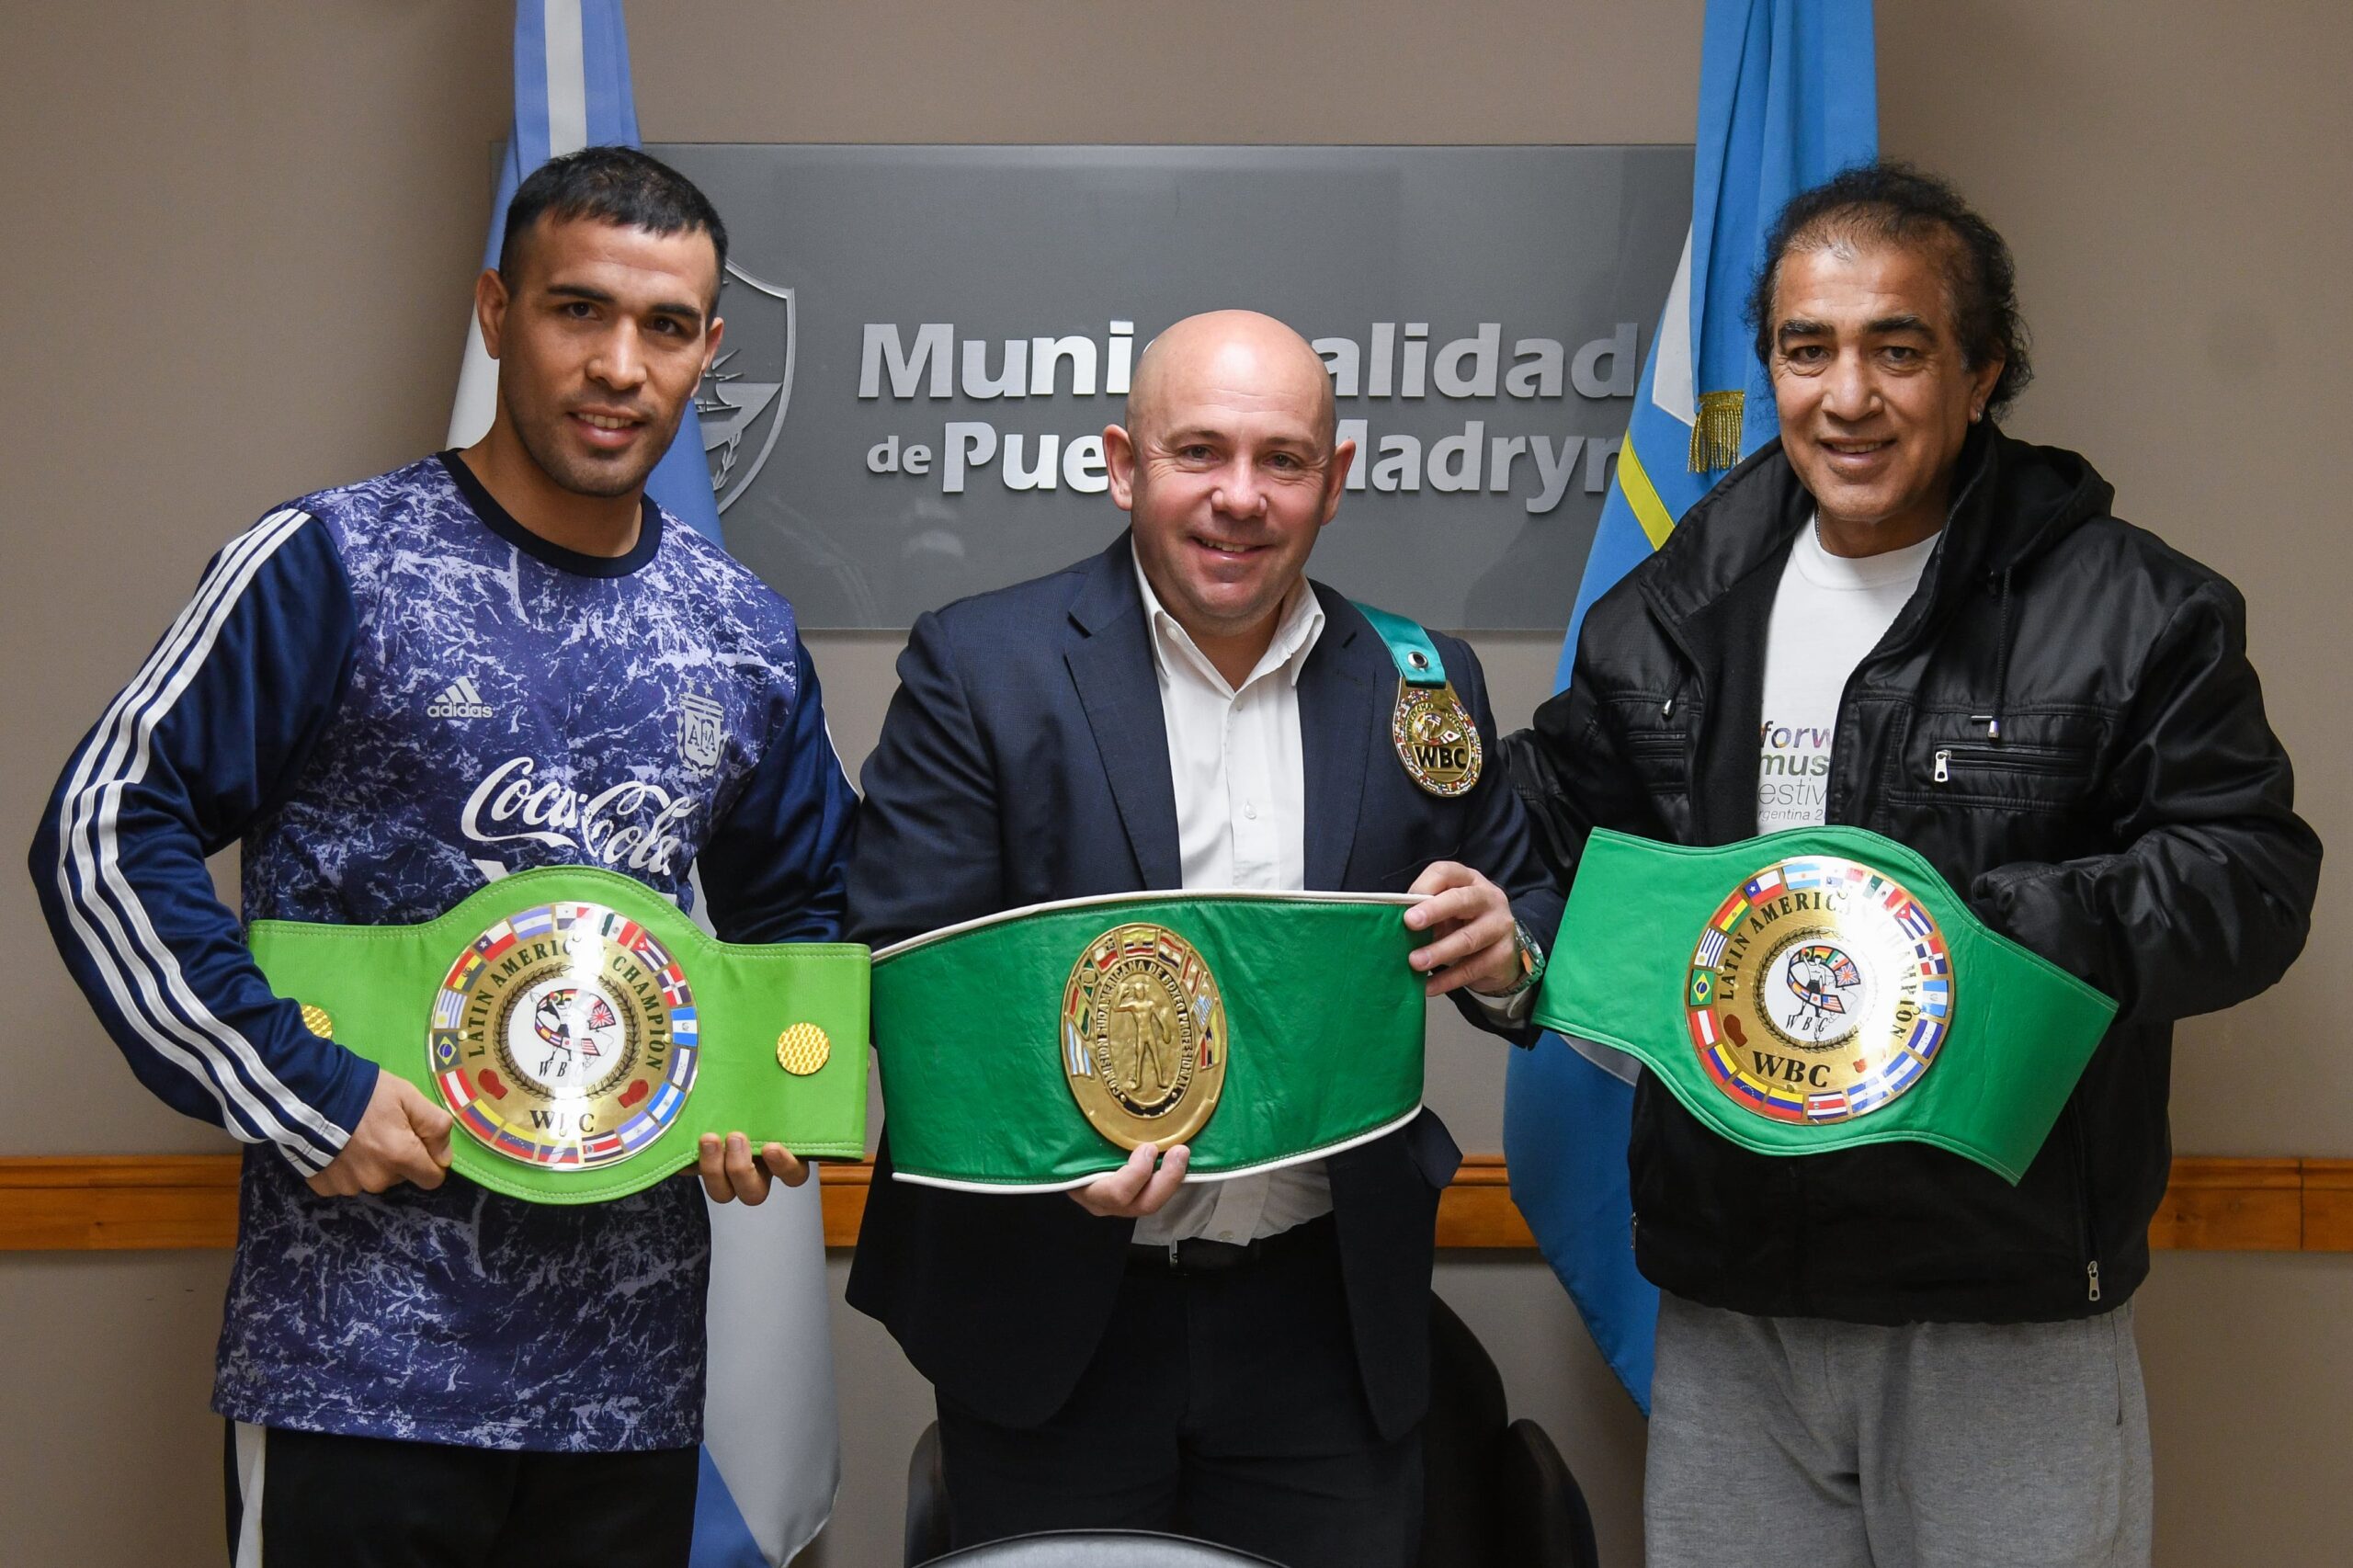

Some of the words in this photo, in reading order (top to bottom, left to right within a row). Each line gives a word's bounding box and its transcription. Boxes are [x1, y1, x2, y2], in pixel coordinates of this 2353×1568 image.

[858, 320, 1638, 399] Munialidad
[866, 436, 932, 474] de
[942, 421, 1109, 493] Pue
[427, 701, 493, 720] adidas
[1413, 745, 1468, 769] WBC
[1760, 754, 1830, 777] mus
[1719, 931, 1751, 1000] LATIN
[1148, 963, 1165, 980] DE
[1161, 973, 1185, 1013] BOXEO
[467, 989, 495, 1058] LATIN
[611, 954, 665, 1072] CHAMPION
[1752, 1050, 1831, 1088] WBC
[529, 1108, 595, 1133] WC
